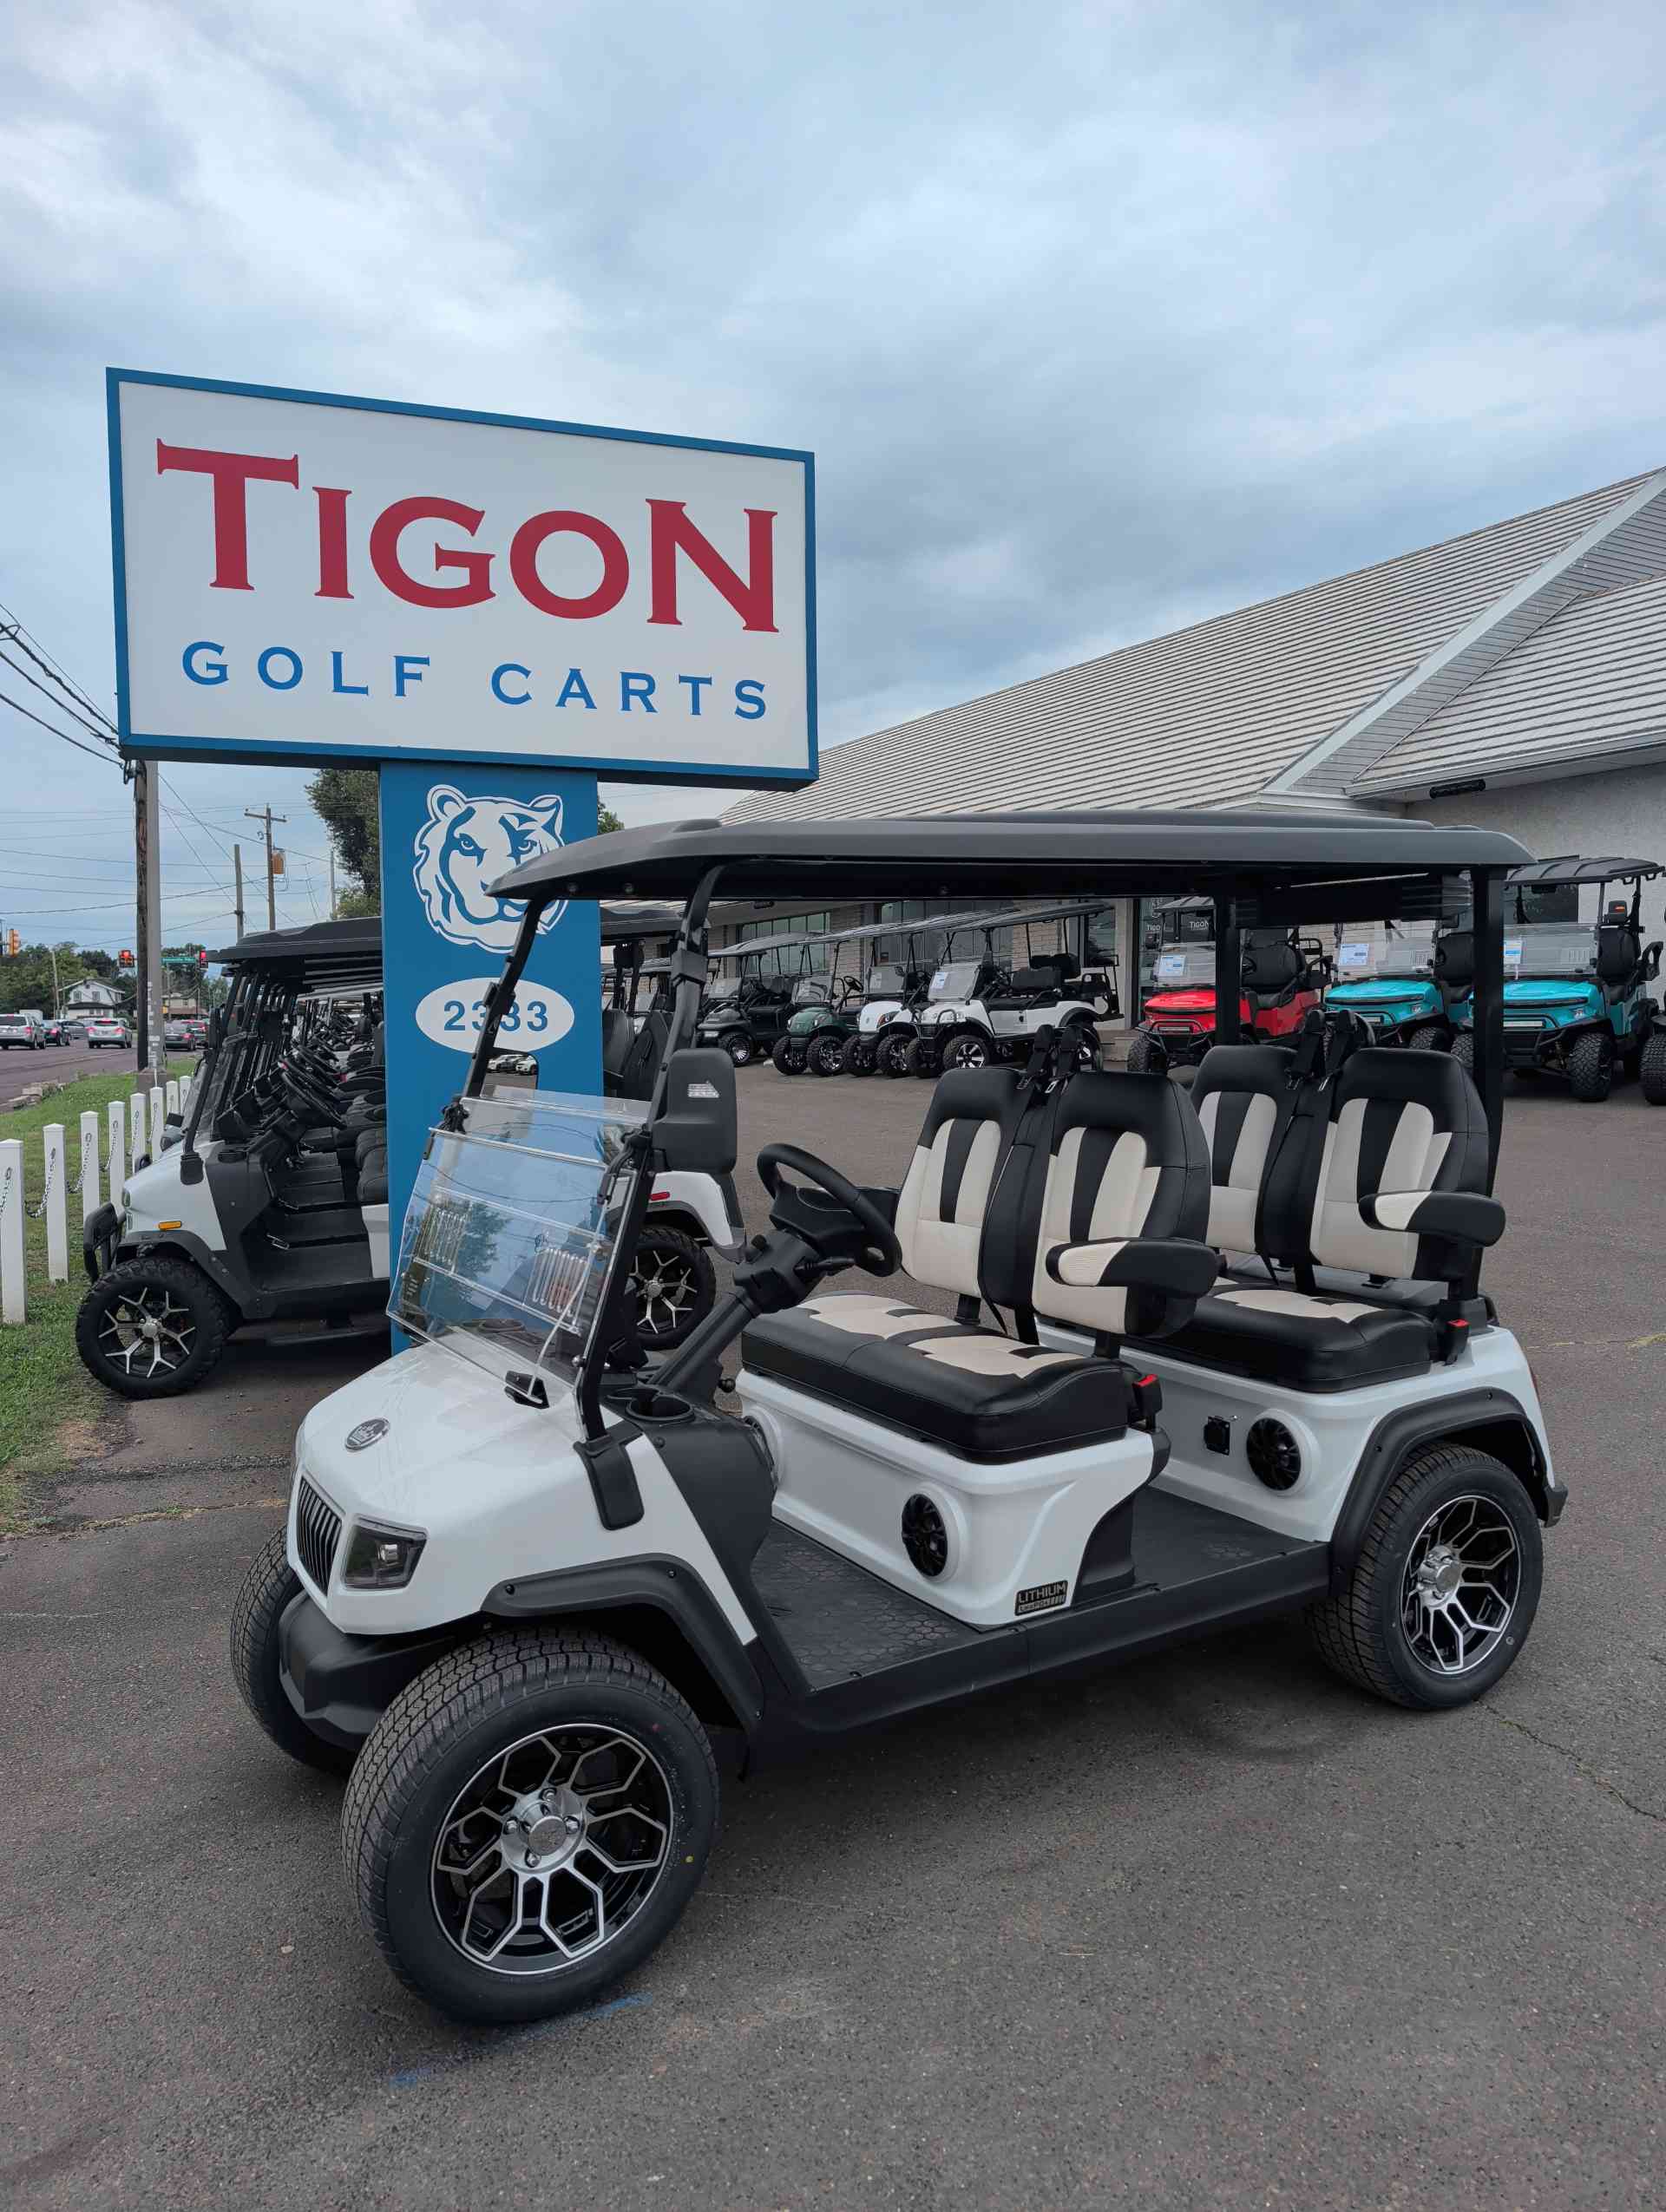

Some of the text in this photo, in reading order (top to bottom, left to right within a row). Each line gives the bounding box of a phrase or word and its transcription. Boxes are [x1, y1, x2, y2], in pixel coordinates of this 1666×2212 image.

[156, 438, 779, 632] TIGON
[182, 641, 765, 719] GOLF CARTS
[1019, 1582, 1066, 1603] LITHIUM
